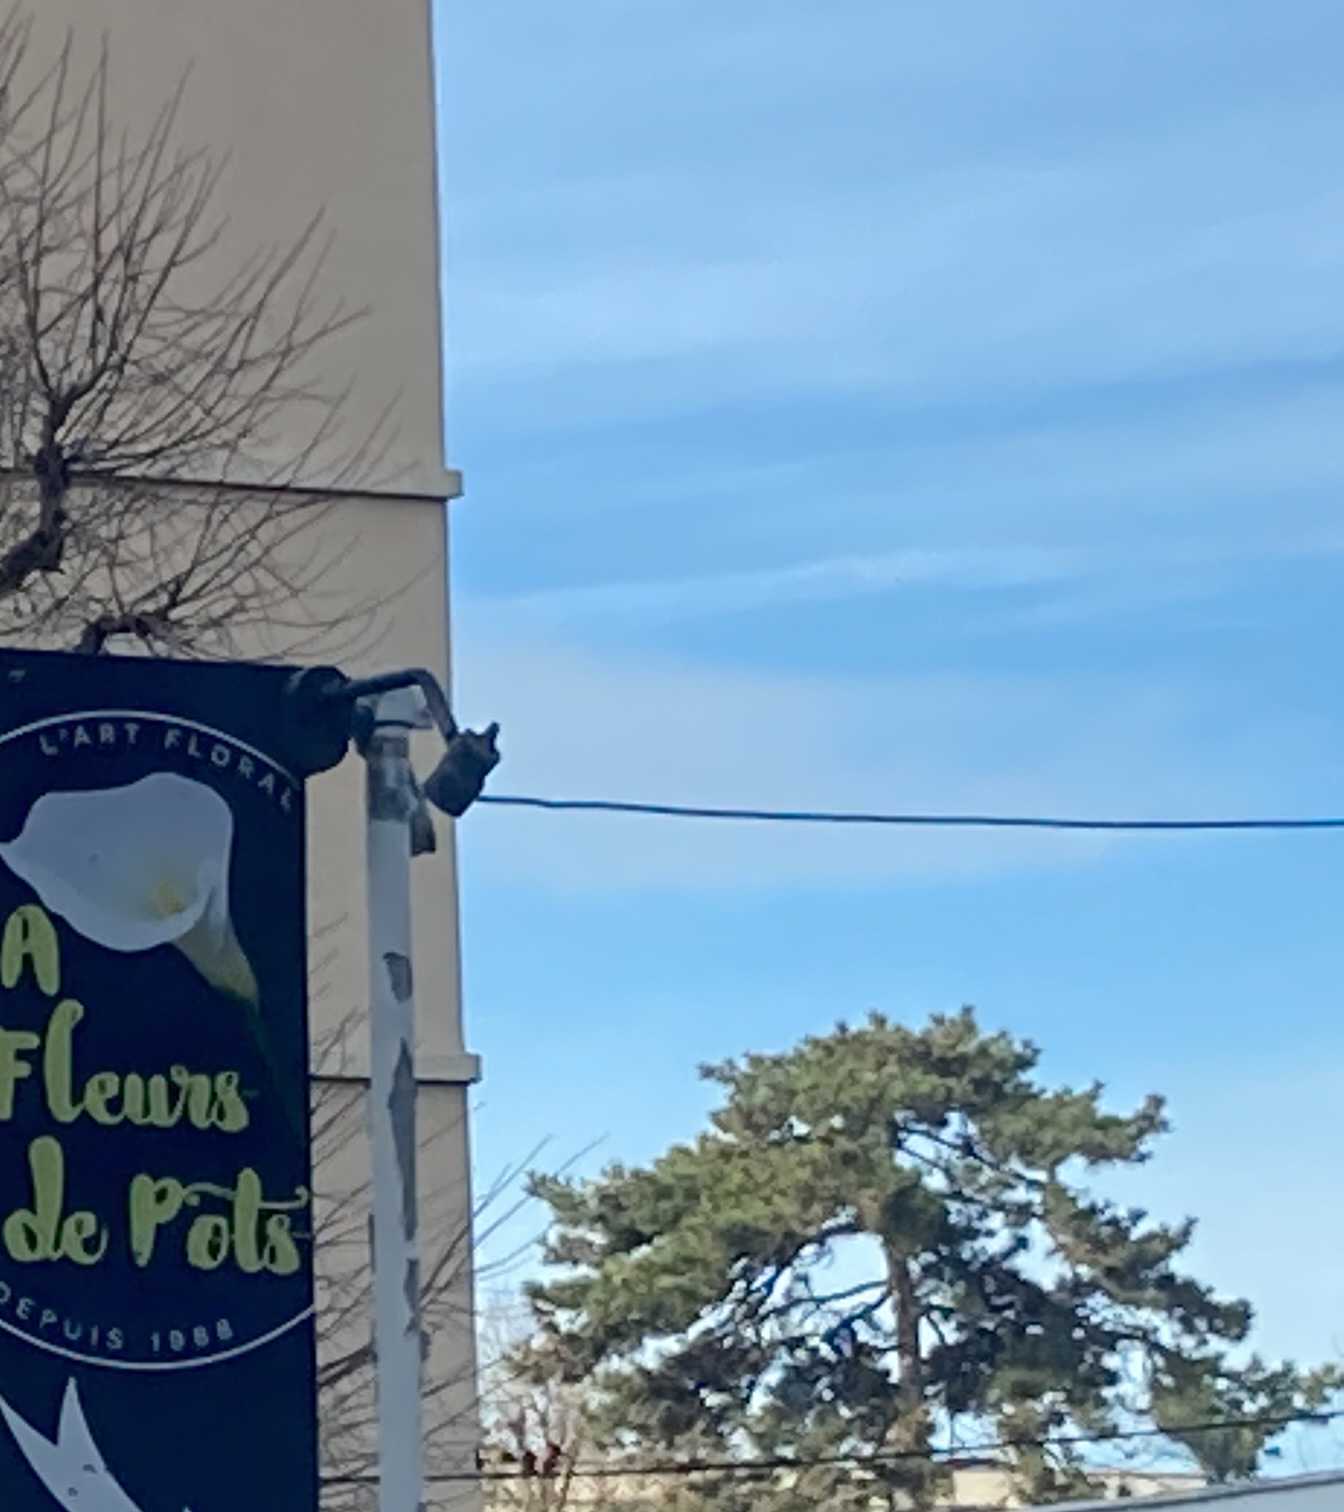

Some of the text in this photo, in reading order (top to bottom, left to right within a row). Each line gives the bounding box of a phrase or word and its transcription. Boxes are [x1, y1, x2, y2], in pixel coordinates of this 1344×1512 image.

[39, 722, 292, 813] L'ART FLORAL
[0, 903, 61, 997] A
[3, 1135, 310, 1276] de Pots
